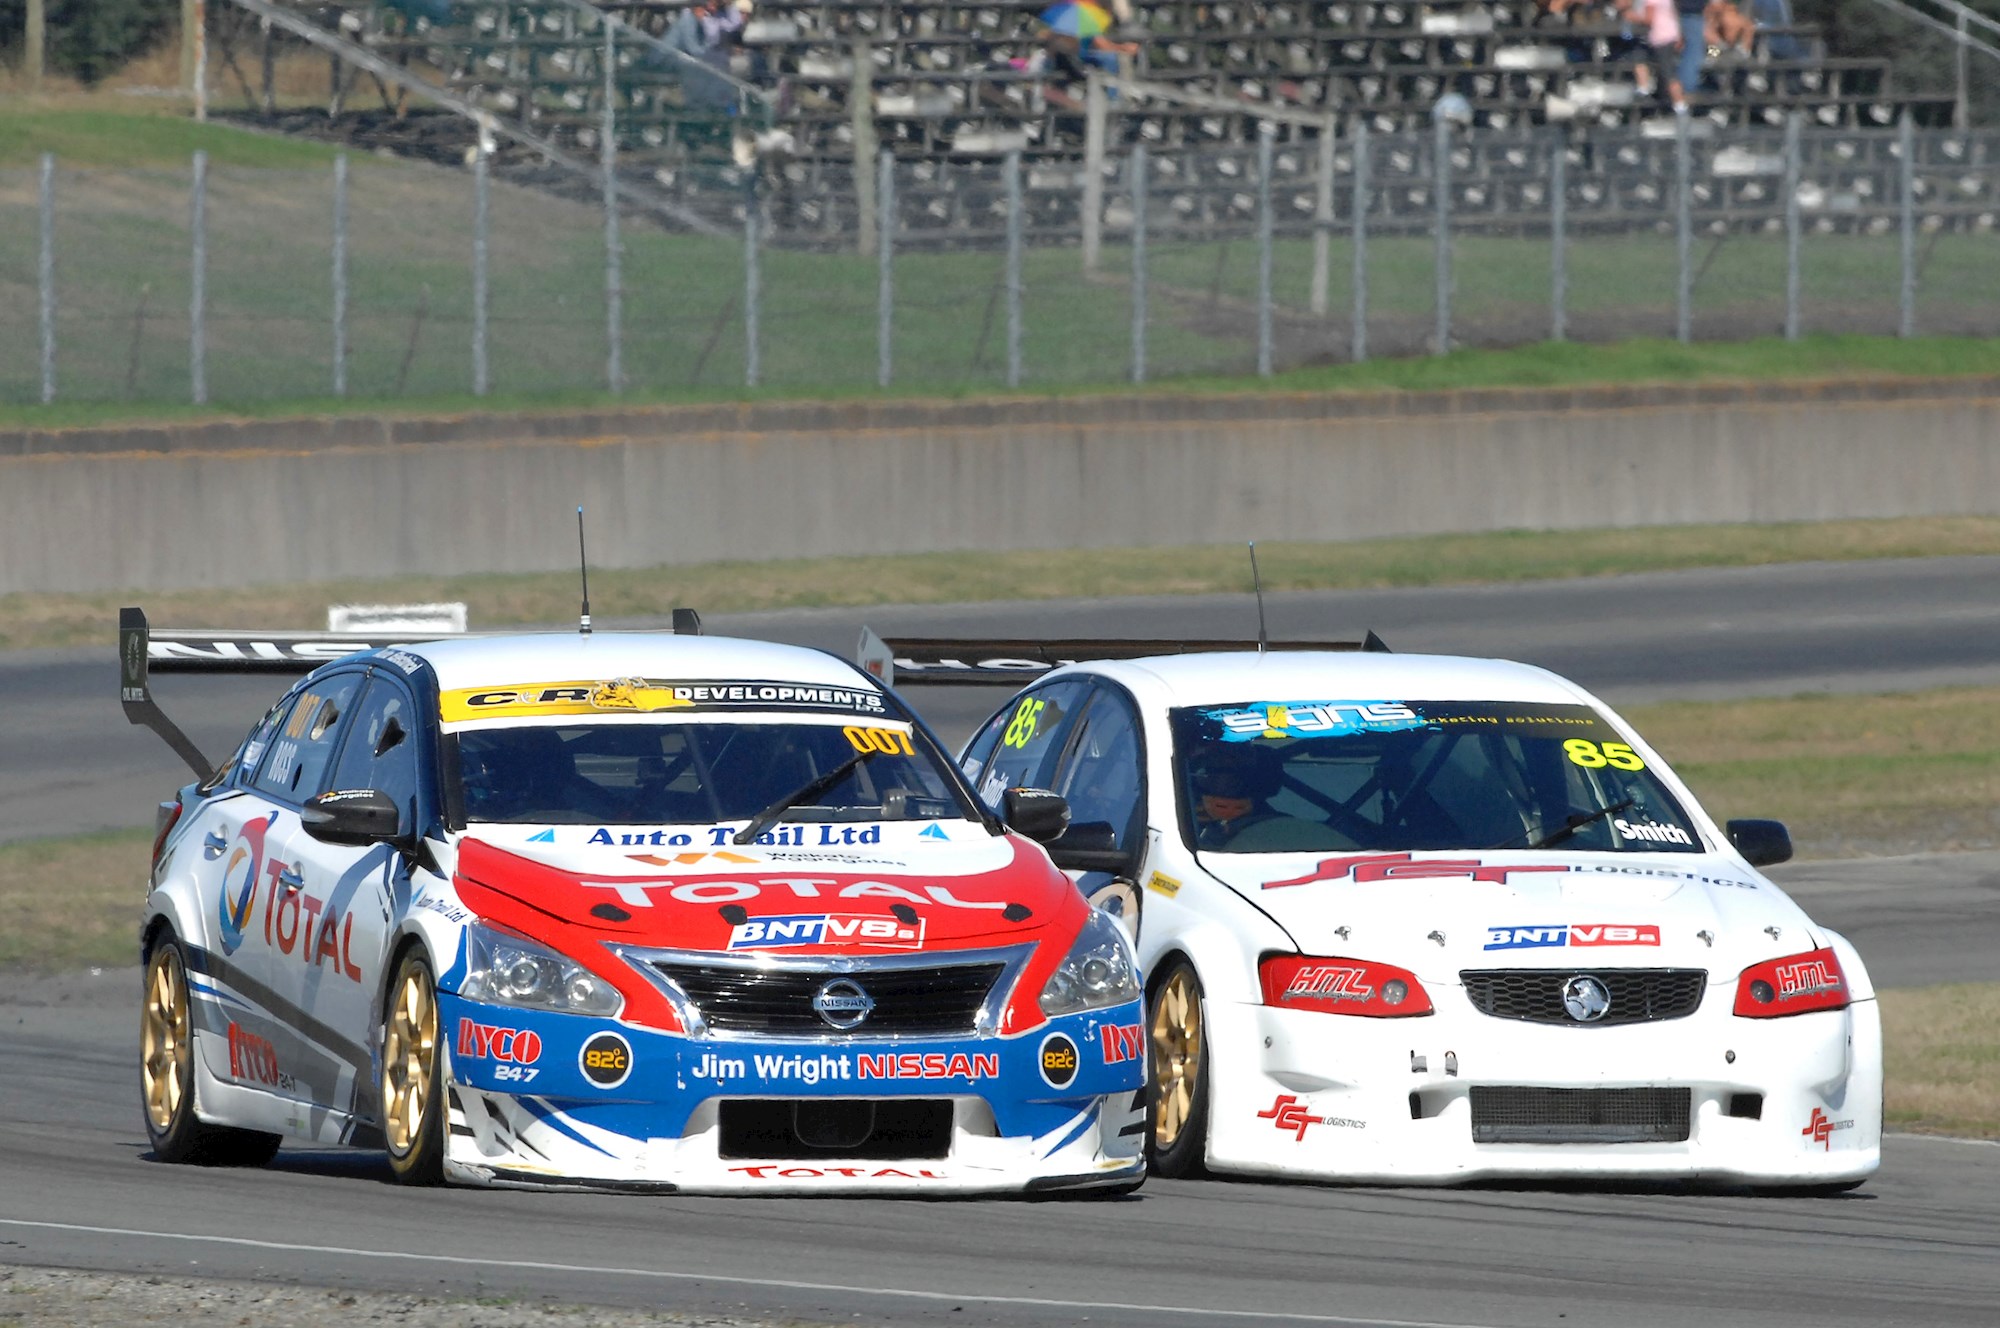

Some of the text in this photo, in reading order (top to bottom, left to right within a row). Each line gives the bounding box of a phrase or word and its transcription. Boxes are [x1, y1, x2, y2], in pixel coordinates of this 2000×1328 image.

[674, 687, 882, 706] DEVELOPMENTS
[855, 703, 886, 713] LTD
[1004, 697, 1045, 749] 85
[1407, 716, 1499, 726] marketing
[1505, 716, 1594, 725] solutions
[842, 726, 915, 755] 007
[1562, 739, 1645, 771] 85
[587, 825, 881, 846] Auto Tail Ltd
[1614, 819, 1693, 845] Smith
[1575, 866, 1759, 889] LOGISTICS
[580, 878, 1007, 910] TOTAL
[264, 858, 361, 984] TOTAL
[821, 999, 867, 1007] NISSAN
[457, 1017, 543, 1065] RYCO
[692, 1053, 1000, 1085] Jim Wright NISSAN
[1322, 1117, 1367, 1129] LOGISTICS
[728, 1165, 949, 1179] TOTAL
